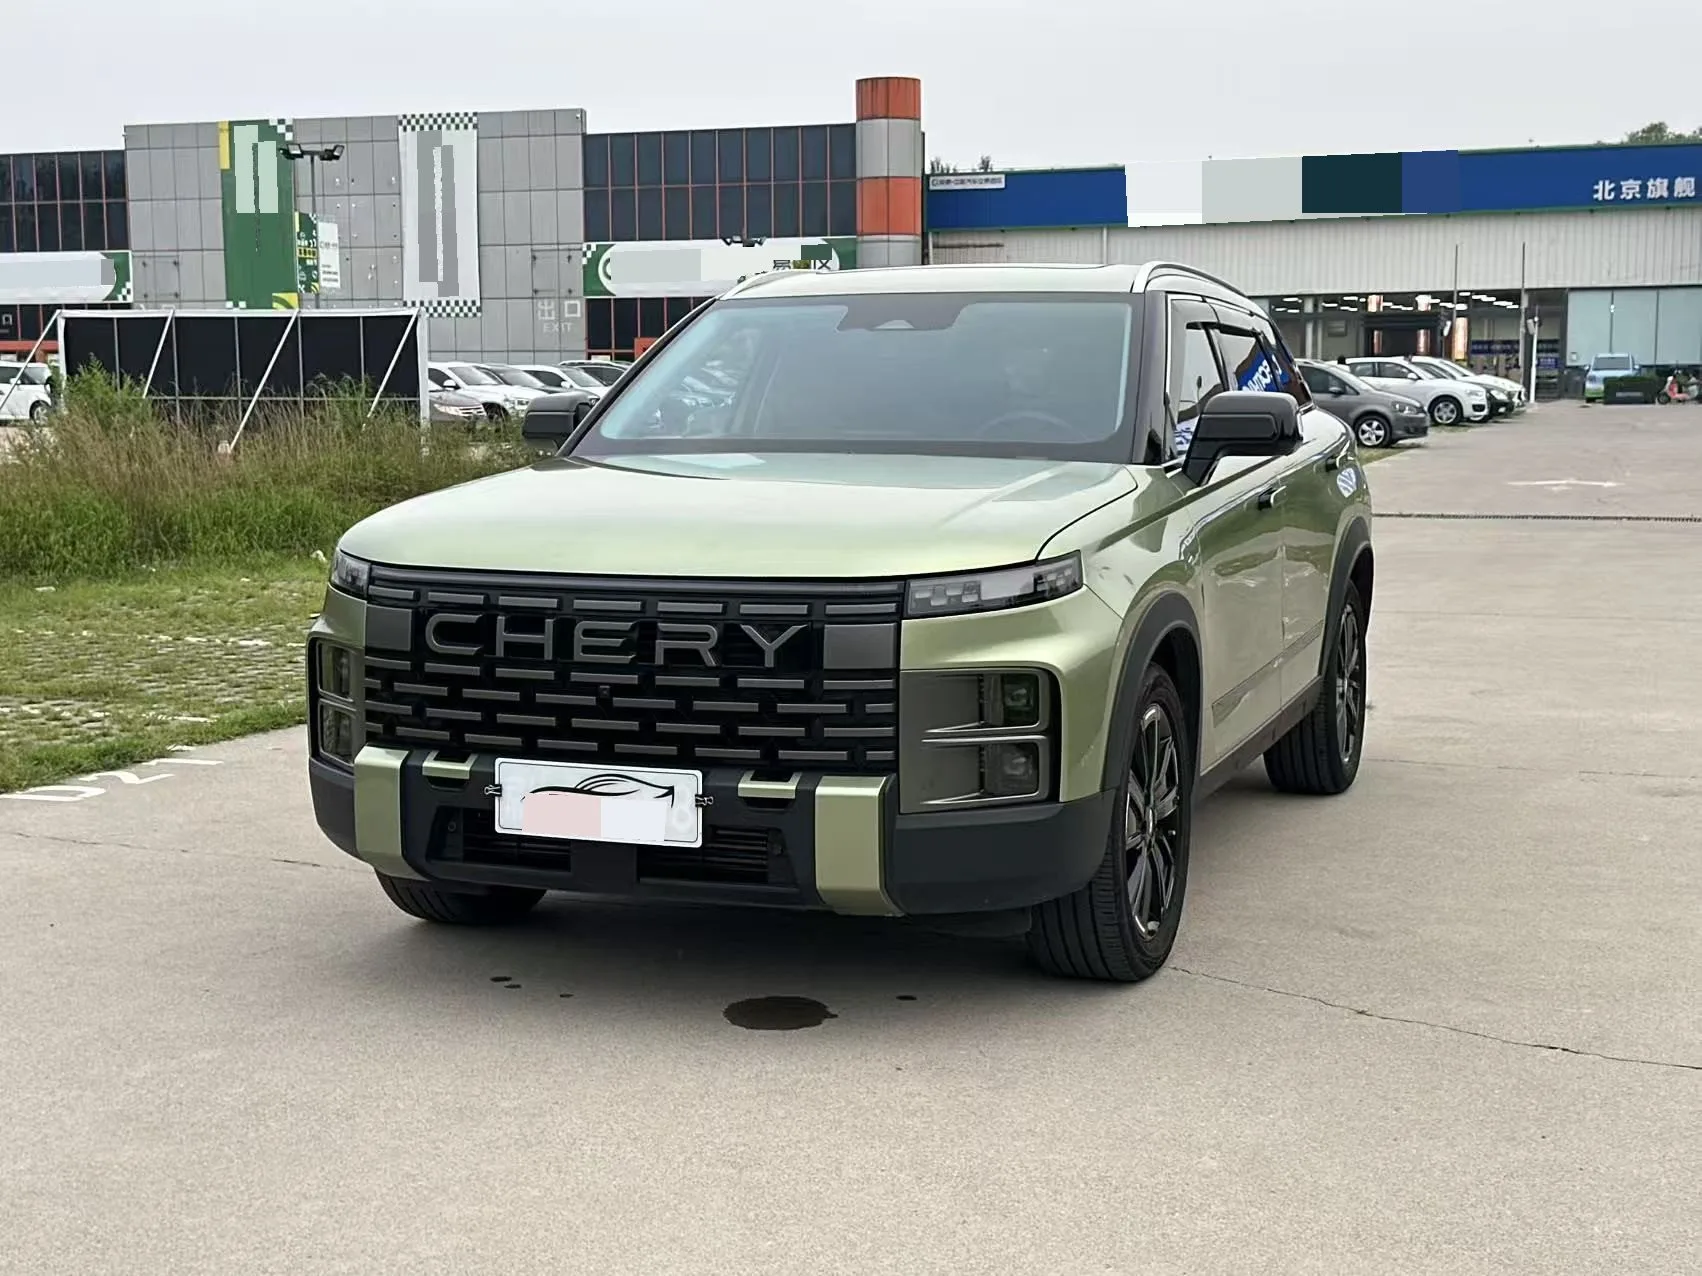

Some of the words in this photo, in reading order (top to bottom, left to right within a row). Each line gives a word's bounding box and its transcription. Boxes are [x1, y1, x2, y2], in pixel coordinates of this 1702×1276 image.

[1593, 177, 1696, 201] 北京旗舰
[537, 299, 581, 320] 出口
[543, 322, 572, 333] EXIT
[425, 613, 809, 668] CHERY
